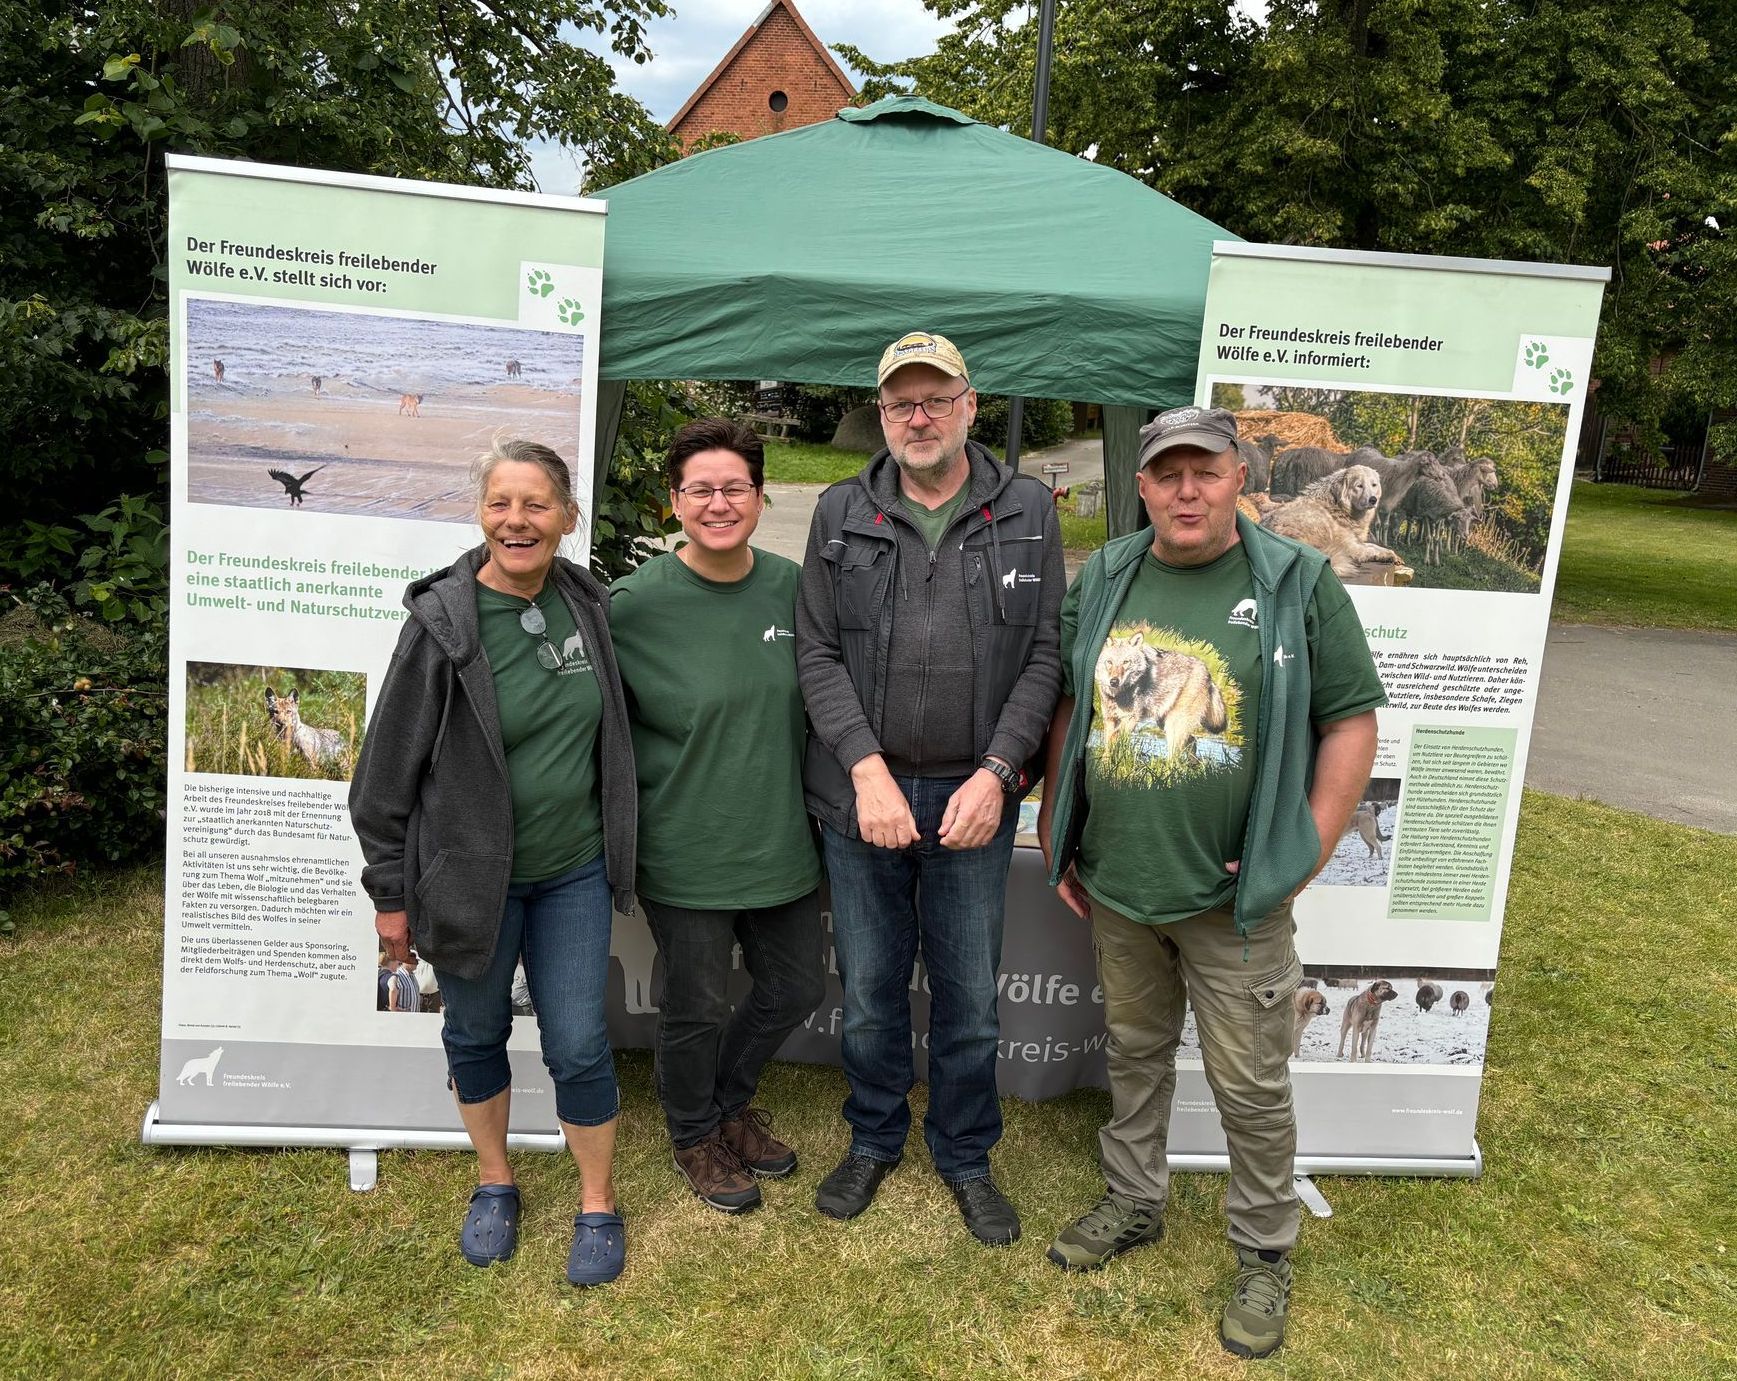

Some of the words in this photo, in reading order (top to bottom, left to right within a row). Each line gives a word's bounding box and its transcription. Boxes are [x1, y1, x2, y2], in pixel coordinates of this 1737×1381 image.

[187, 236, 215, 252] Der
[220, 240, 333, 264] Freundeskreis
[339, 251, 436, 274] freilebender
[187, 260, 234, 278] Wölfe
[239, 266, 268, 281] e.V.
[273, 270, 315, 286] stellt
[320, 273, 351, 289] sich
[356, 279, 386, 292] vor:
[1219, 323, 1245, 338] Der
[1249, 325, 1350, 344] Freundeskreis
[1355, 331, 1443, 350] freilebender
[1217, 346, 1259, 361] Wölfe
[1263, 349, 1288, 363] e.V.
[1294, 350, 1369, 368] informiert:
[187, 550, 214, 564] Der
[219, 552, 325, 572] Freundeskreis
[331, 560, 427, 580] freilebender
[186, 571, 219, 586] eine
[224, 576, 291, 591] staatlich
[296, 581, 382, 598] anerkannte
[187, 592, 251, 609] Umwelt-
[257, 598, 284, 612] und
[1365, 625, 1408, 639] schutz
[1372, 651, 1383, 659] ölfe
[1422, 652, 1438, 660] sich
[1442, 654, 1490, 662] hauptsächlich
[1512, 656, 1528, 665] Reh,
[1410, 662, 1456, 671] Schwarzwild.
[1457, 664, 1477, 673] Wölfe
[1477, 666, 1527, 674] unterscheiden
[1380, 671, 1412, 679] zwischen
[1413, 672, 1432, 680] Wild-
[1448, 674, 1485, 682] Nutztieren.
[1487, 675, 1509, 683] Daher
[1509, 676, 1525, 684] kön-
[1396, 682, 1439, 690] ausreichend
[1442, 684, 1480, 692] geschützte
[1483, 685, 1500, 693] oder
[1389, 691, 1421, 701] Nutztiere,
[1423, 692, 1469, 701] insbesondere
[1471, 694, 1496, 703] Schafe,
[1498, 696, 1522, 705] Ziegen
[1422, 702, 1442, 710] Beute
[1443, 703, 1457, 711] des
[1458, 704, 1481, 712] Wolfes
[198, 785, 234, 794] bisherige
[236, 786, 269, 796] intensive
[288, 790, 331, 801] nachhaltige
[183, 794, 206, 802] Arbeit
[208, 795, 222, 803] des
[224, 796, 285, 806] Freundeskreises
[287, 800, 332, 809] freilebender
[225, 806, 234, 814] im
[236, 807, 251, 815] Jahr
[253, 808, 271, 816] 2018
[273, 809, 285, 817] mit
[286, 810, 299, 818] der
[301, 810, 341, 822] Ernennung
[236, 818, 283, 826] anerkannten
[285, 820, 332, 829] Naturschutz-
[183, 835, 208, 843] schutz
[234, 827, 255, 835] durch
[257, 828, 270, 836] das
[272, 829, 314, 839] Bundesamt
[316, 831, 327, 839] für
[329, 833, 352, 841] Natur-
[182, 850, 195, 858] Bei
[196, 850, 206, 858] all
[240, 854, 290, 862] ausnahmslos
[292, 856, 349, 866] ehrenamtlichen
[182, 860, 224, 868] Aktivitäten
[301, 866, 313, 874] die
[314, 867, 346, 876] Bevölke-
[182, 871, 200, 879] rung
[220, 872, 245, 880] Thema
[246, 873, 263, 881] Wolf
[182, 880, 200, 888] über
[201, 881, 216, 889] das
[244, 883, 256, 891] die
[258, 884, 288, 894] Biologie
[306, 886, 319, 894] das
[321, 888, 356, 896] Verhalten
[181, 890, 194, 898] der
[196, 891, 218, 899] Wölfe
[234, 893, 295, 903] wissenschaftlich
[297, 896, 338, 906] belegbaren
[182, 900, 207, 908] Fakten
[261, 904, 292, 912] Dadurch
[294, 906, 326, 914] möchten
[340, 908, 352, 916] ein
[181, 920, 210, 928] Umwelt
[180, 965, 193, 973] der
[194, 966, 248, 976] Feldforschung
[266, 969, 292, 977] Thema
